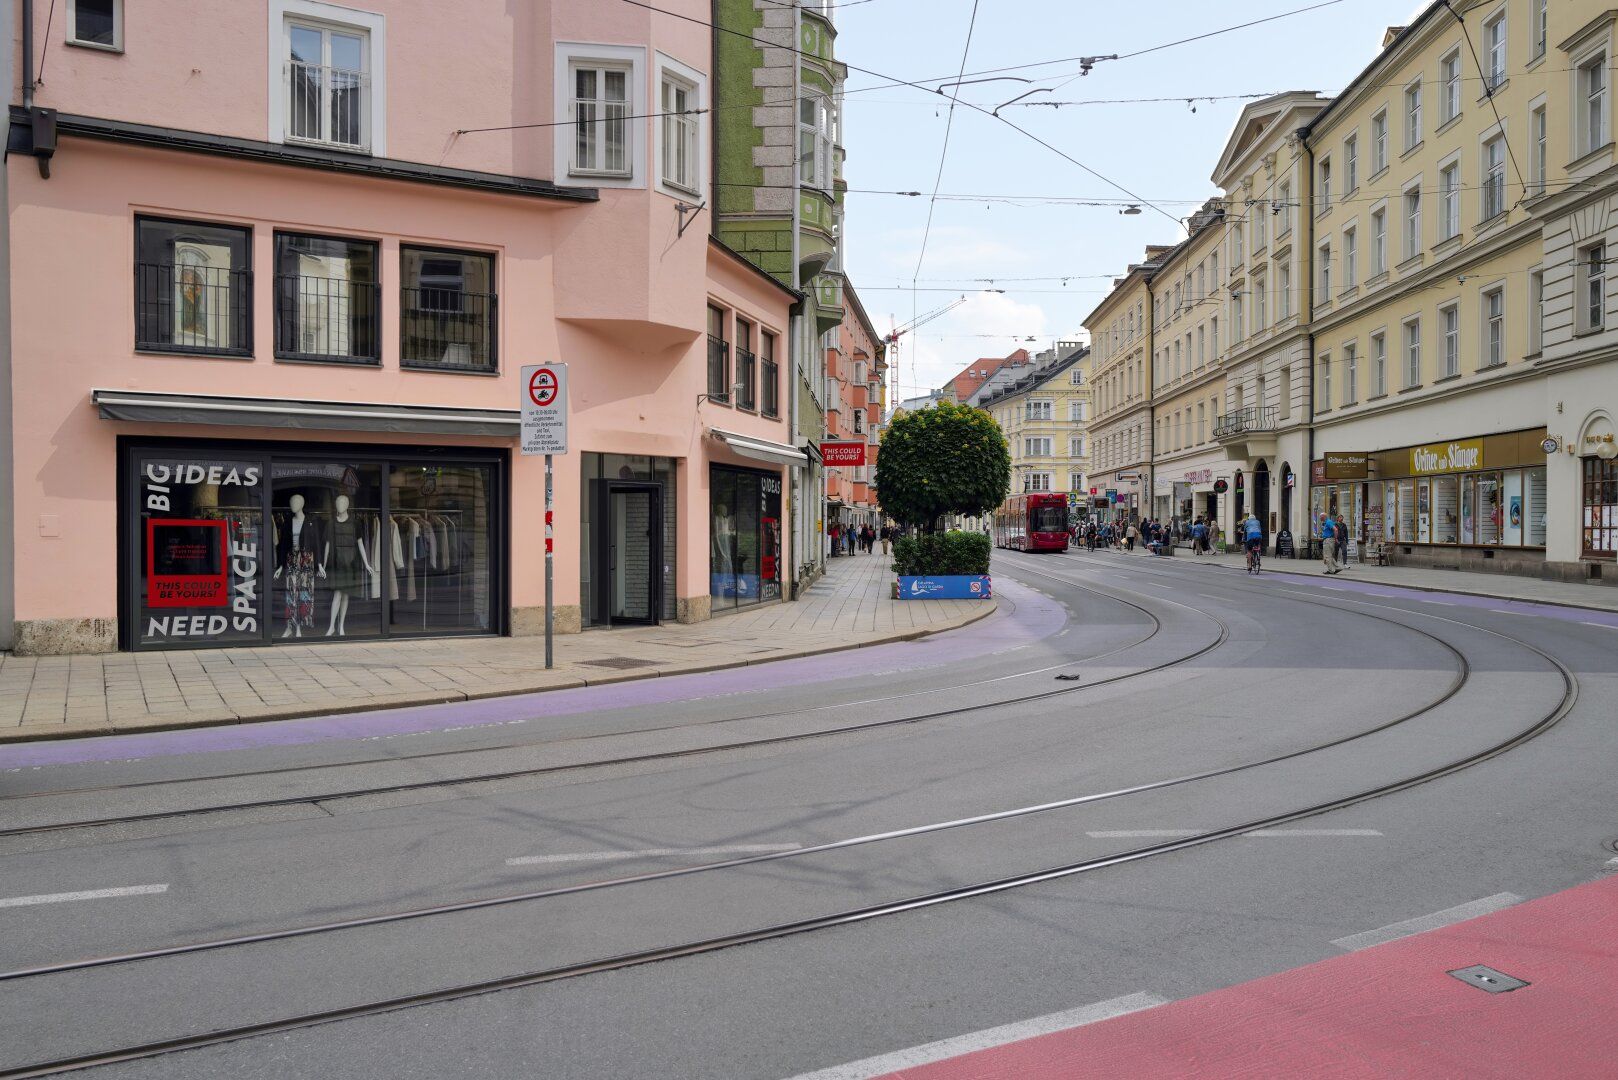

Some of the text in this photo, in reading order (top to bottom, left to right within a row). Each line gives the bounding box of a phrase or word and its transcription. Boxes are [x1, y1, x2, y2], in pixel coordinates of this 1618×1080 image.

[174, 464, 259, 487] IDEAS
[146, 464, 170, 512] BIG
[156, 581, 222, 590] THIS COULD
[160, 590, 217, 598] BE YOURS!
[233, 540, 257, 632] SPACE
[148, 615, 228, 636] NEED
